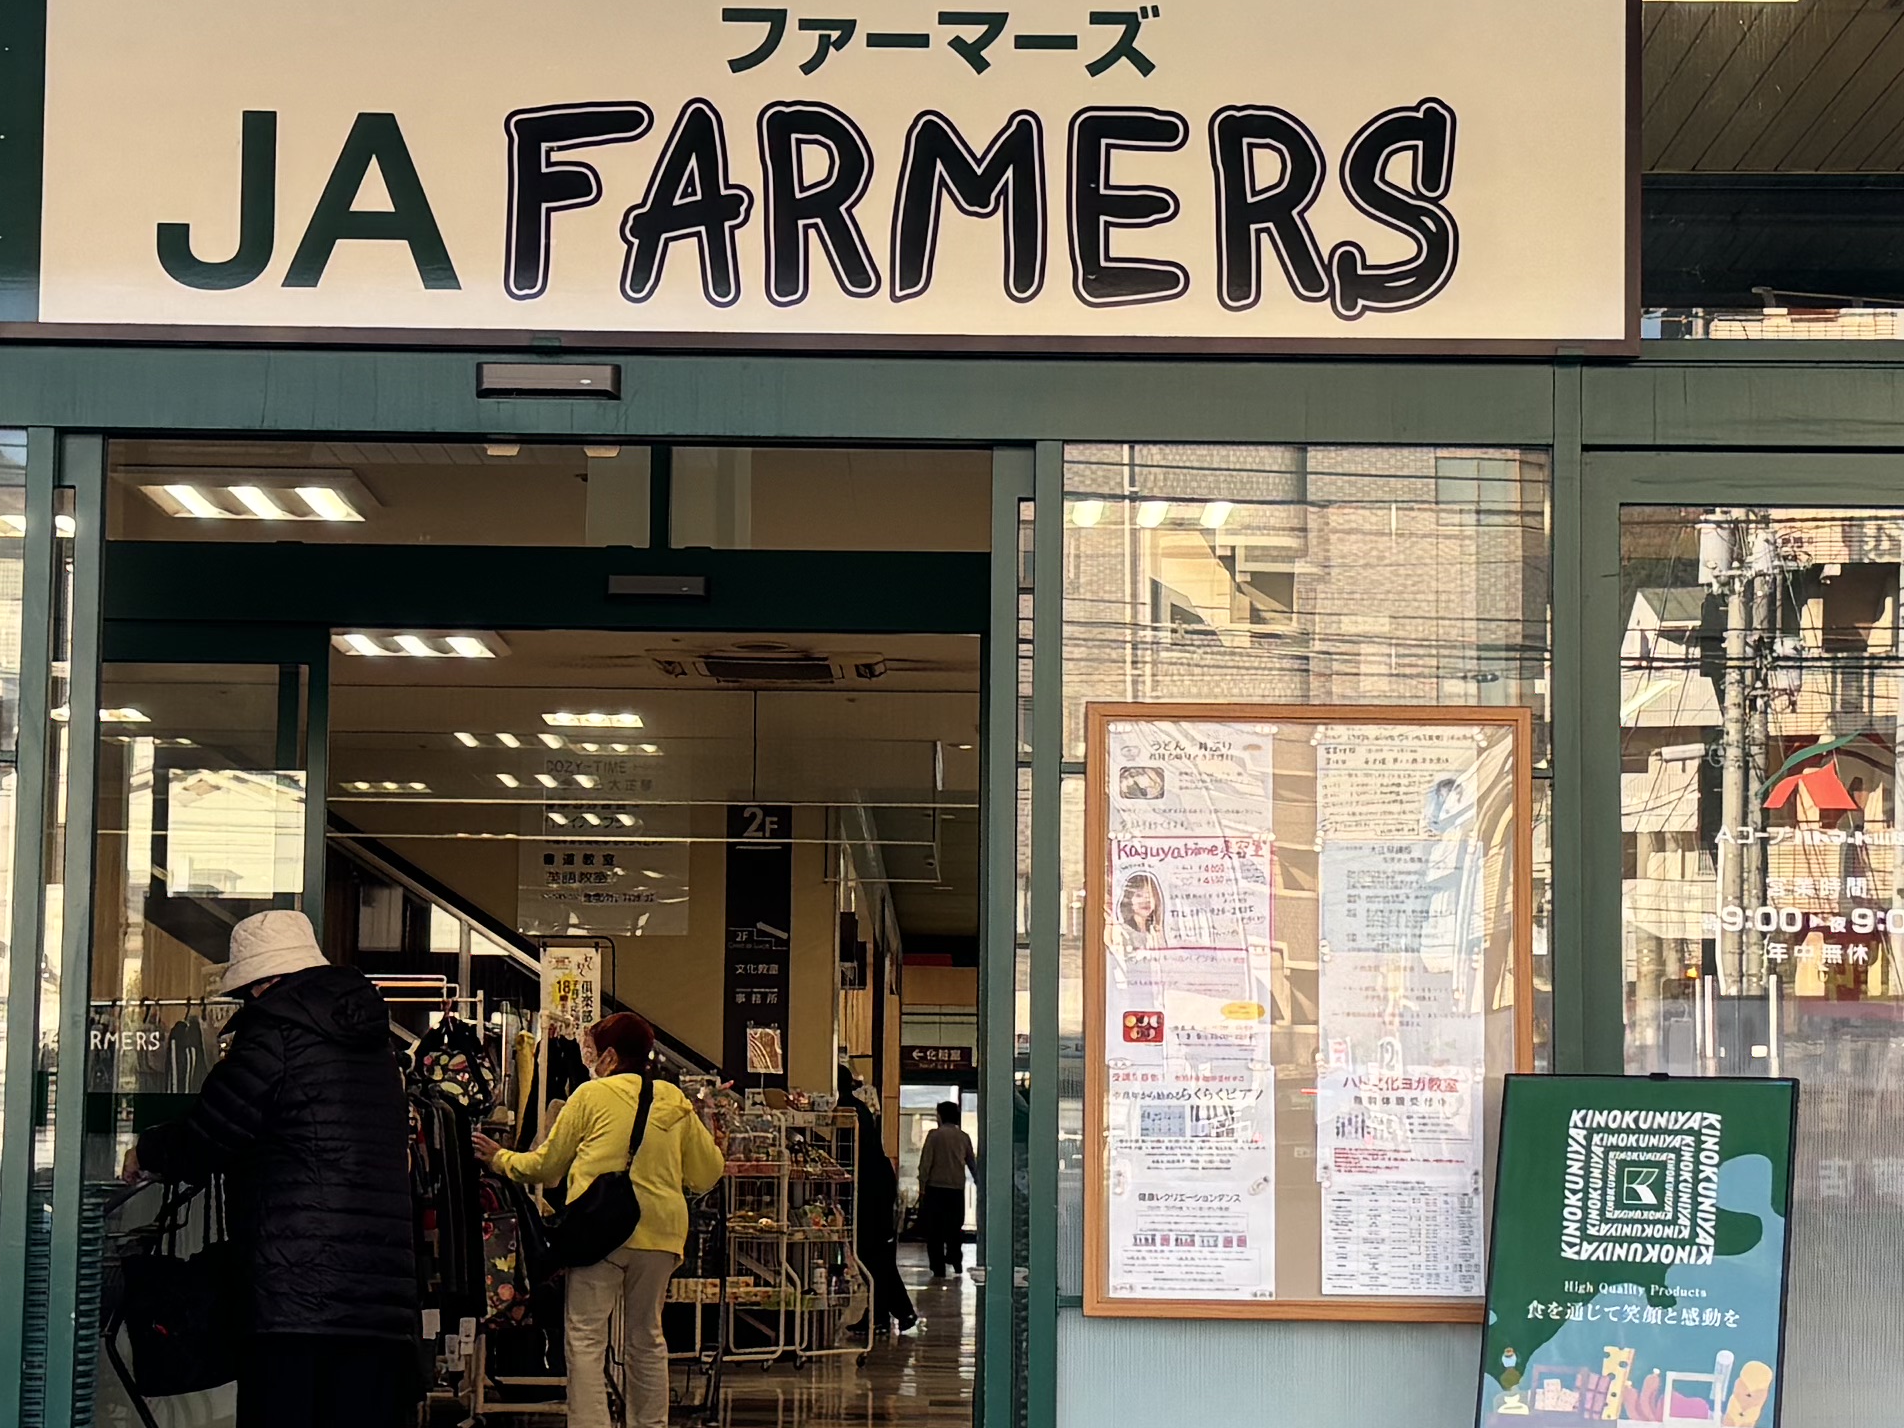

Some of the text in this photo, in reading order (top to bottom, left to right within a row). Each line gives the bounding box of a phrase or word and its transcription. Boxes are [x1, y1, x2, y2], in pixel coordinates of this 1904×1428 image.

[721, 2, 1161, 77] ファーマーズ
[156, 96, 1458, 321] JA FARMERS
[742, 807, 779, 838] 2F
[1767, 943, 1869, 965] 年中無休
[1569, 1109, 1703, 1130] KINOKUNIYA
[1591, 1133, 1681, 1148] KINOKUNIYA
[1561, 1127, 1588, 1260] KINOKUNIYA
[1586, 1144, 1605, 1236] KINOKUNIYA
[1677, 1135, 1695, 1226] KINOKUNIYA
[1695, 1112, 1722, 1246] KINOKUNIYA
[1599, 1223, 1690, 1239] KINOKUNIYA
[1579, 1241, 1714, 1265] KINOKUNIYA
[1564, 1280, 1707, 1298] High Quality Products
[1526, 1298, 1740, 1329] 食を通じて笑顔と感動を
